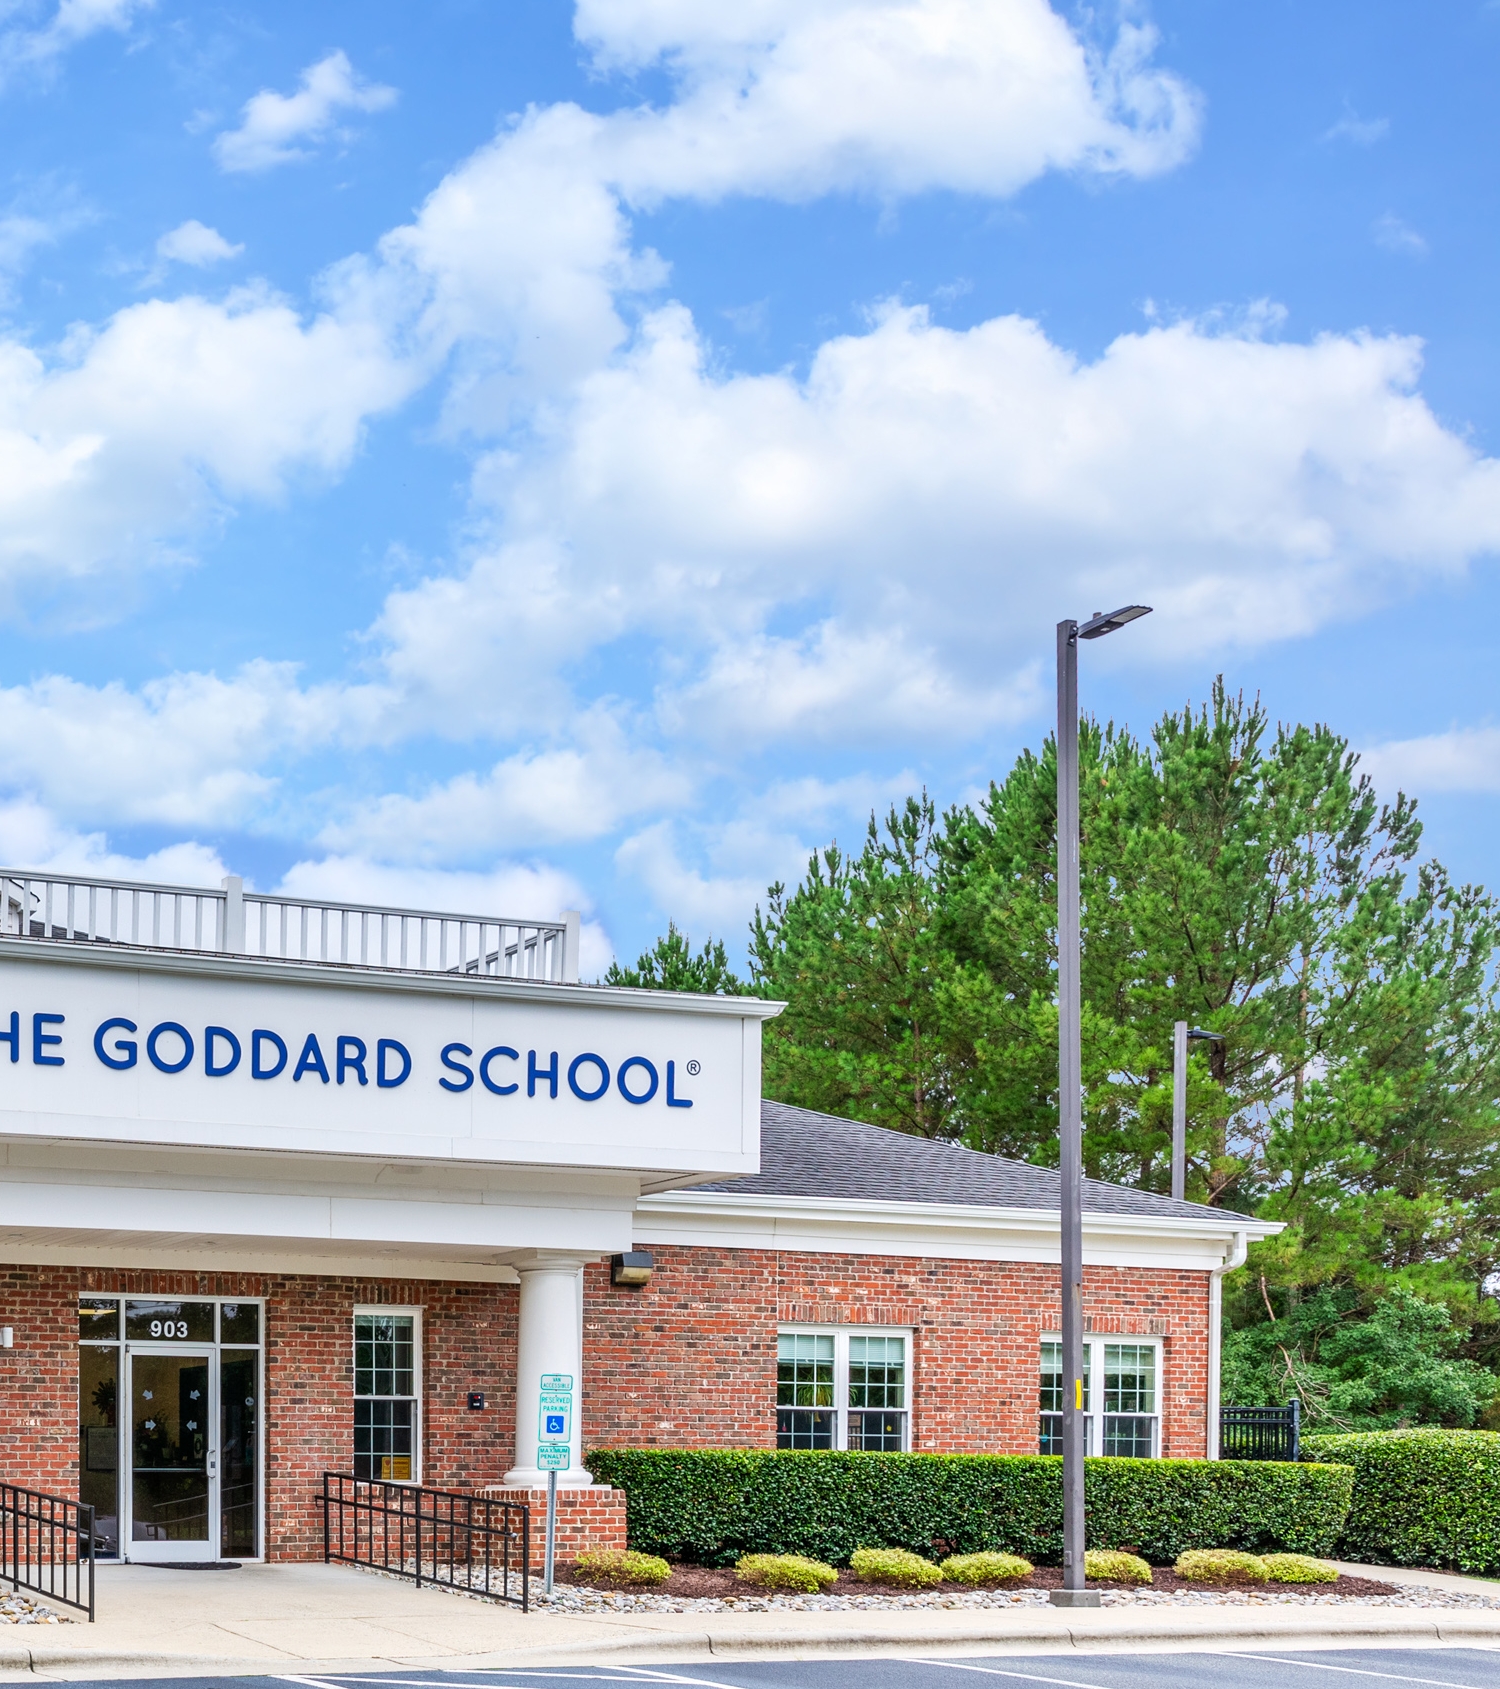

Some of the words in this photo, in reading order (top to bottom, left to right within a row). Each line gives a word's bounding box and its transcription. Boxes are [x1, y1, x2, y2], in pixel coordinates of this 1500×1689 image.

[93, 1017, 412, 1088] GODDARD
[150, 1320, 188, 1338] 903
[541, 1396, 570, 1404] RESERVED
